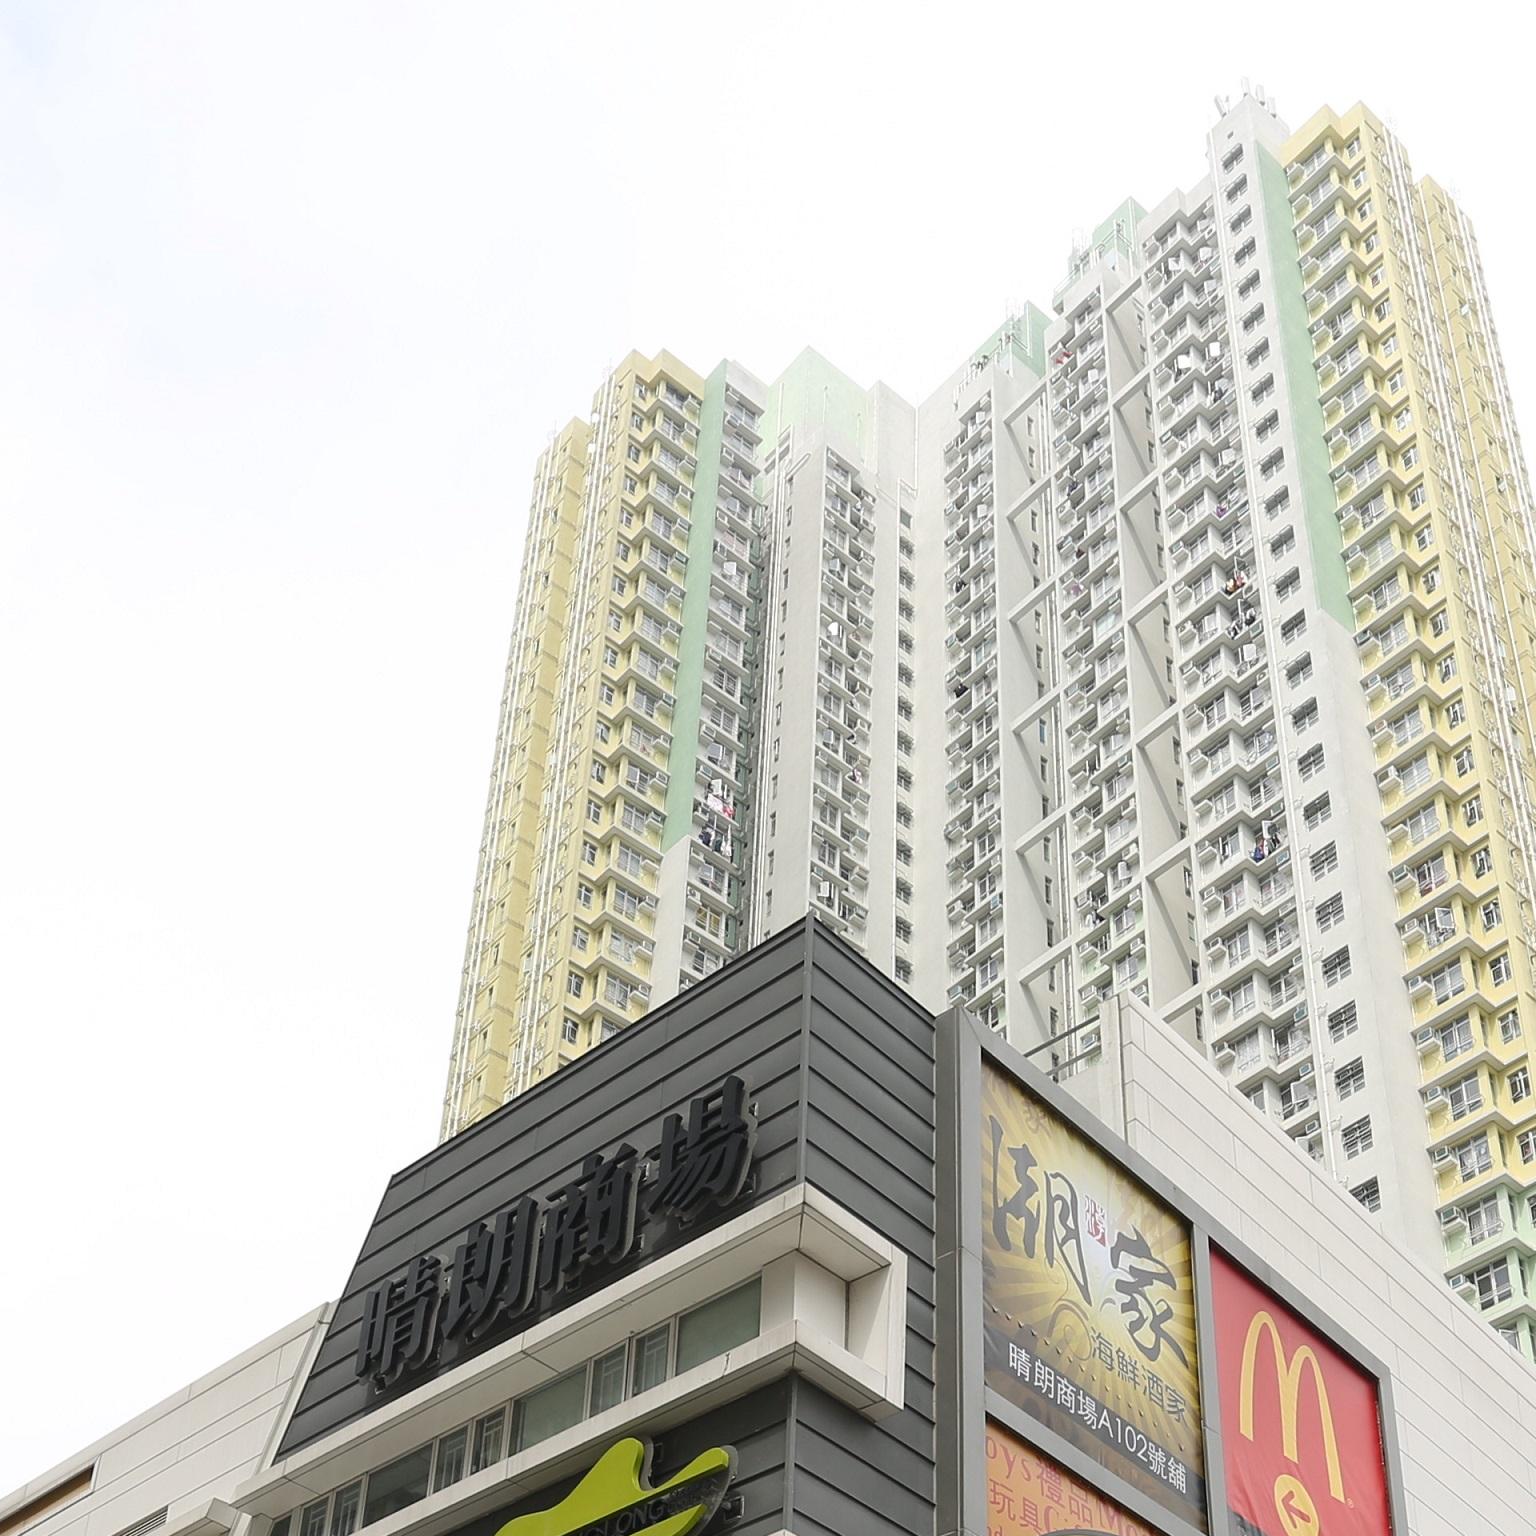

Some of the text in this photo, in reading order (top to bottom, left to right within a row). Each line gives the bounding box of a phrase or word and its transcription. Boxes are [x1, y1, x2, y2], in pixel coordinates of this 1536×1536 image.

[356, 1075, 752, 1380] 晴朗商場
[1008, 1342, 1187, 1494] 晴朗商場A102號舖
[1091, 1327, 1187, 1427] 海鮮酒家
